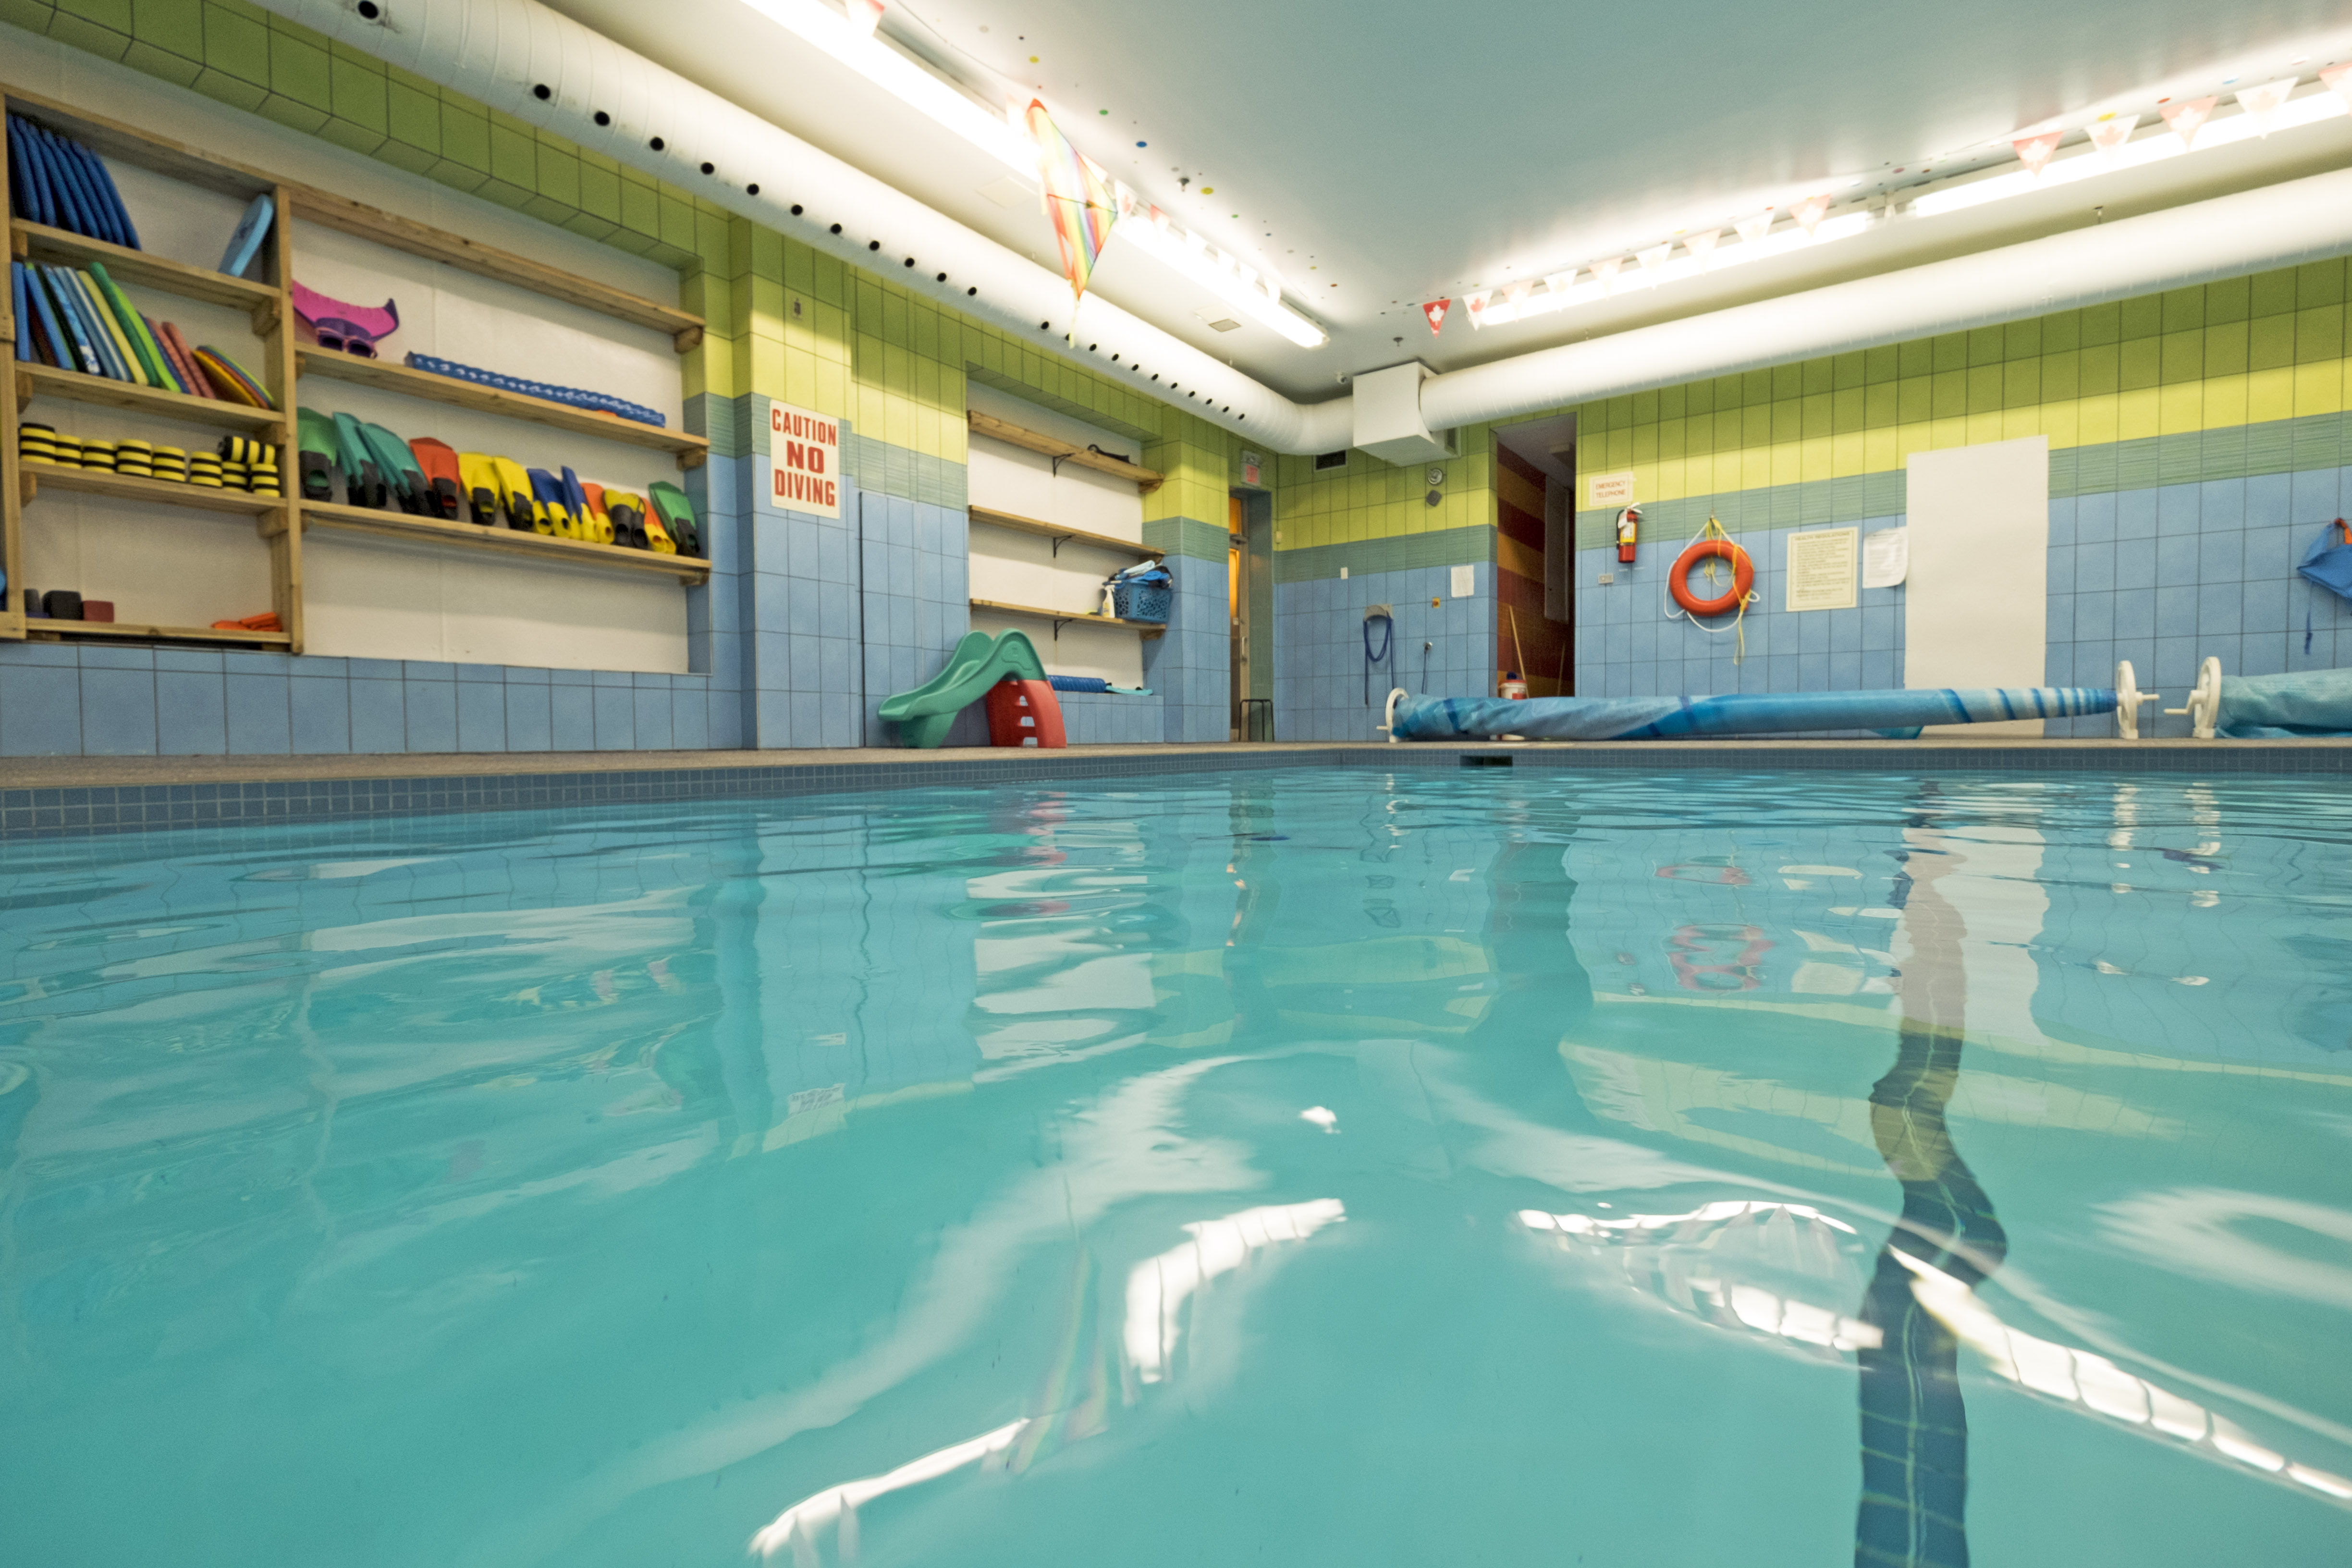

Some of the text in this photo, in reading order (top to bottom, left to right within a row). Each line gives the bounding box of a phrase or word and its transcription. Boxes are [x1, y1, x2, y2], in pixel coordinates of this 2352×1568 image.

[772, 408, 836, 446] CAUTION
[787, 440, 824, 474] NO
[774, 469, 835, 507] DIVING
[1595, 480, 1626, 490] EMERGENCY
[1596, 489, 1626, 498] TELEPHONE
